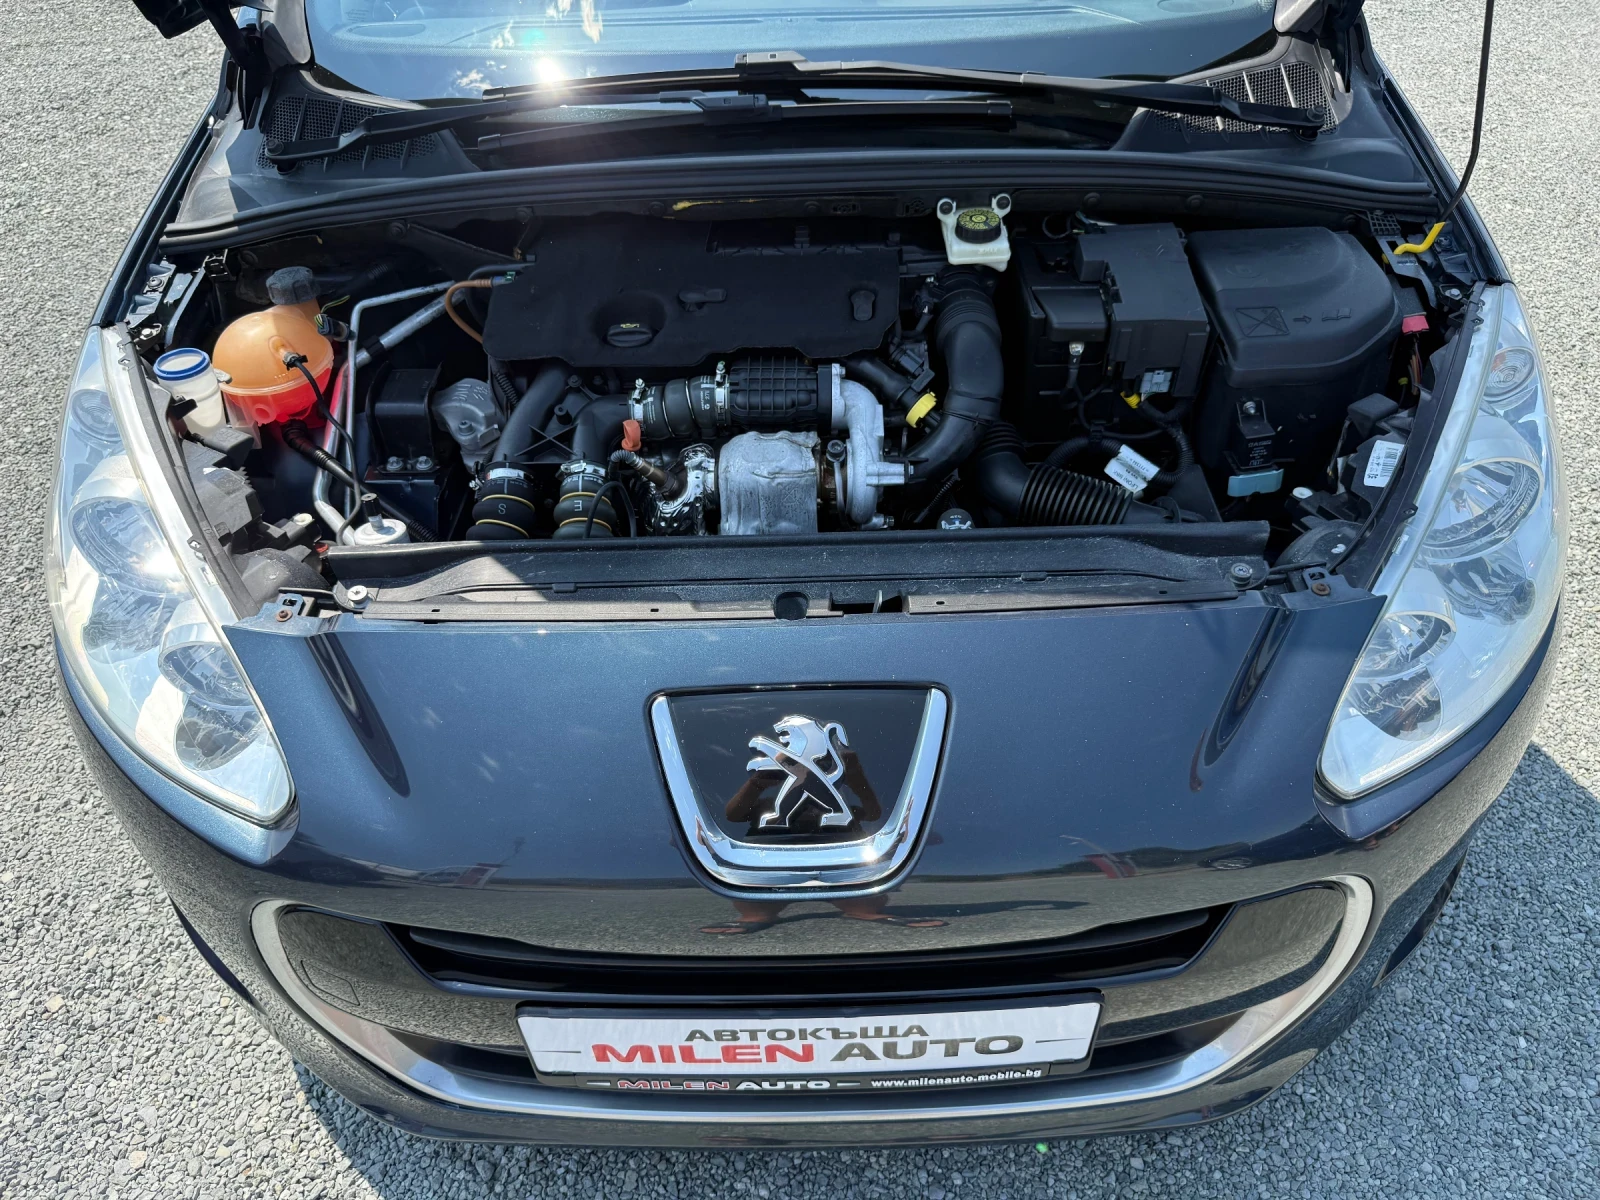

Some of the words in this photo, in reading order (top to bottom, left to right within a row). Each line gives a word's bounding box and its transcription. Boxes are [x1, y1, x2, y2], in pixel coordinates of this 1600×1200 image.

[498, 503, 507, 514] S
[591, 1043, 815, 1064] MILEN
[830, 1035, 1024, 1062] AUTO
[618, 1080, 730, 1090] MILEN
[736, 1080, 831, 1090] AUTO
[871, 1069, 1042, 1088] www.milenauto.mobile.bg
